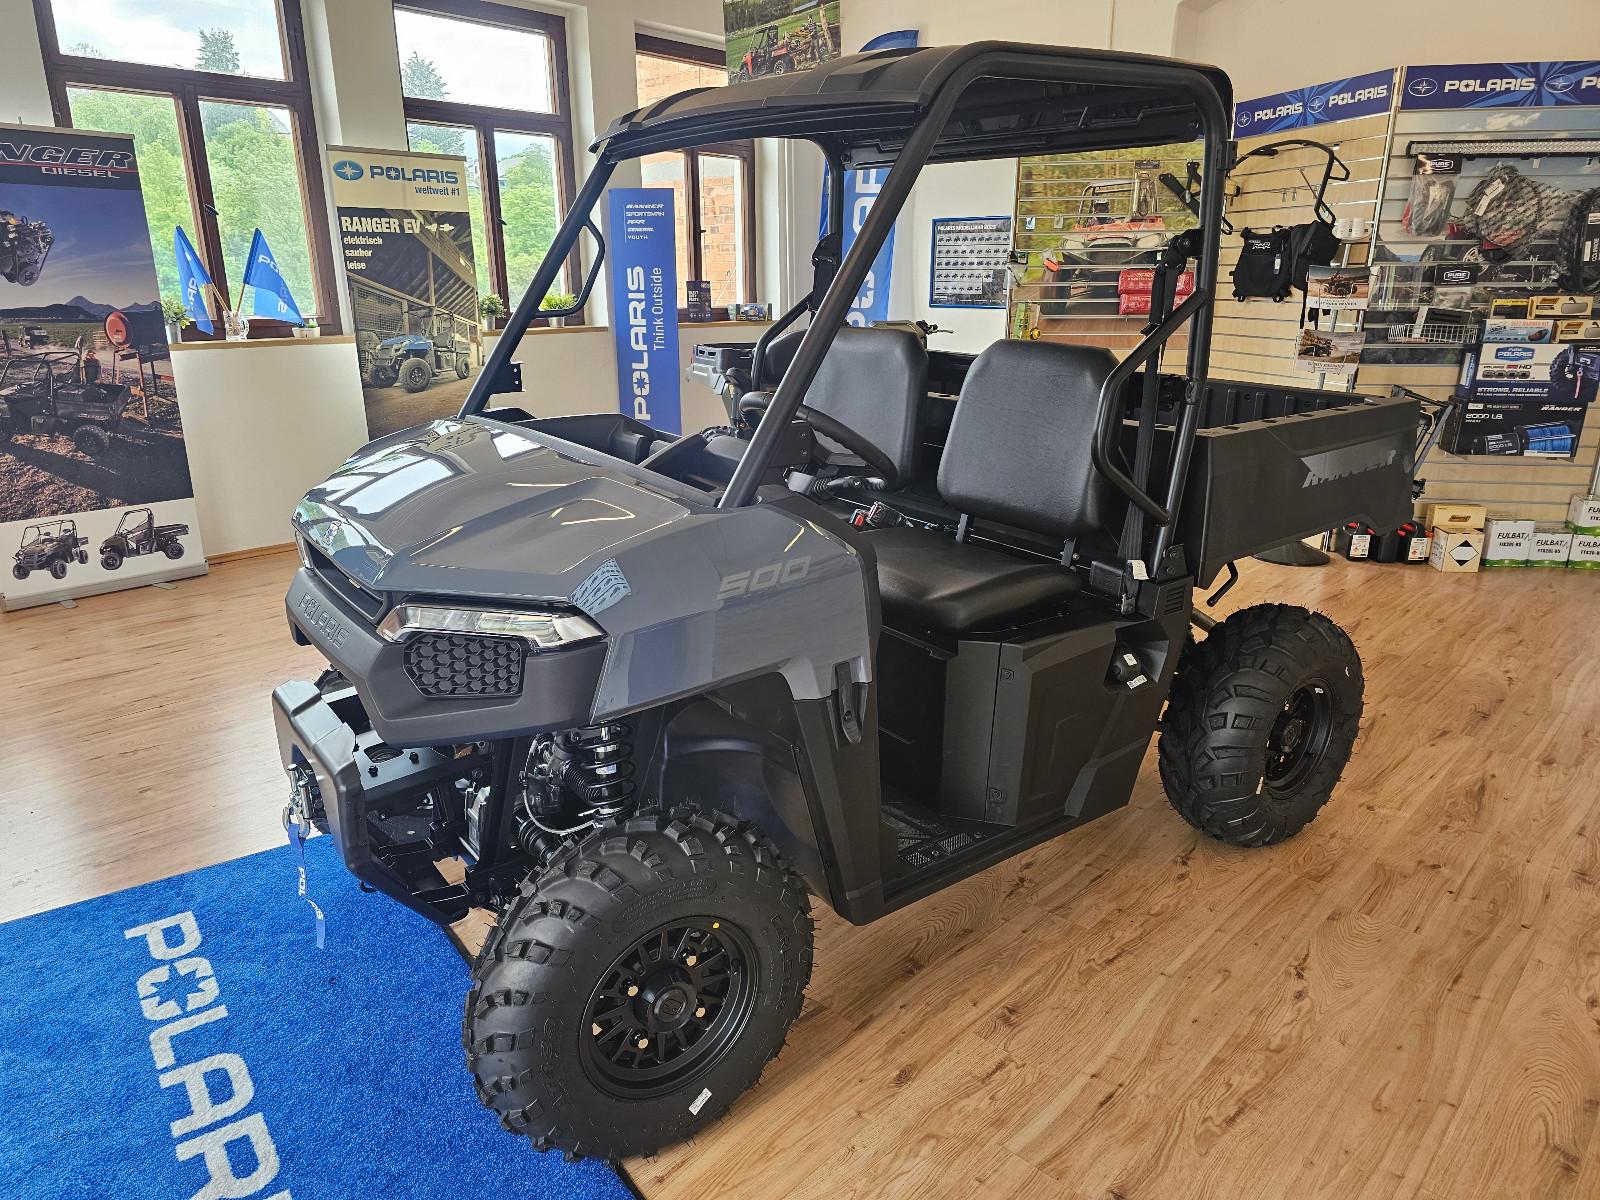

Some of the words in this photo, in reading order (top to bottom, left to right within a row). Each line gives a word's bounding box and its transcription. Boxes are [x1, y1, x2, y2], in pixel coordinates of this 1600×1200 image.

[1444, 78, 1536, 93] POLARIS
[1329, 85, 1388, 107] POLARIS
[1254, 102, 1303, 122] POLARIS
[41, 167, 121, 178] DIESEL
[369, 165, 459, 185] POLARIS
[415, 186, 449, 196] weltweit
[451, 187, 460, 196] #1
[340, 217, 400, 233] RANGER
[403, 218, 422, 234] EV
[343, 236, 383, 245] elektrisch
[345, 249, 373, 257] sauber
[347, 261, 366, 270] leise
[650, 267, 664, 314] Outside
[626, 266, 651, 421] POLARIS
[653, 317, 665, 351] Think
[717, 555, 812, 600] 500
[297, 591, 349, 649] POLARIS
